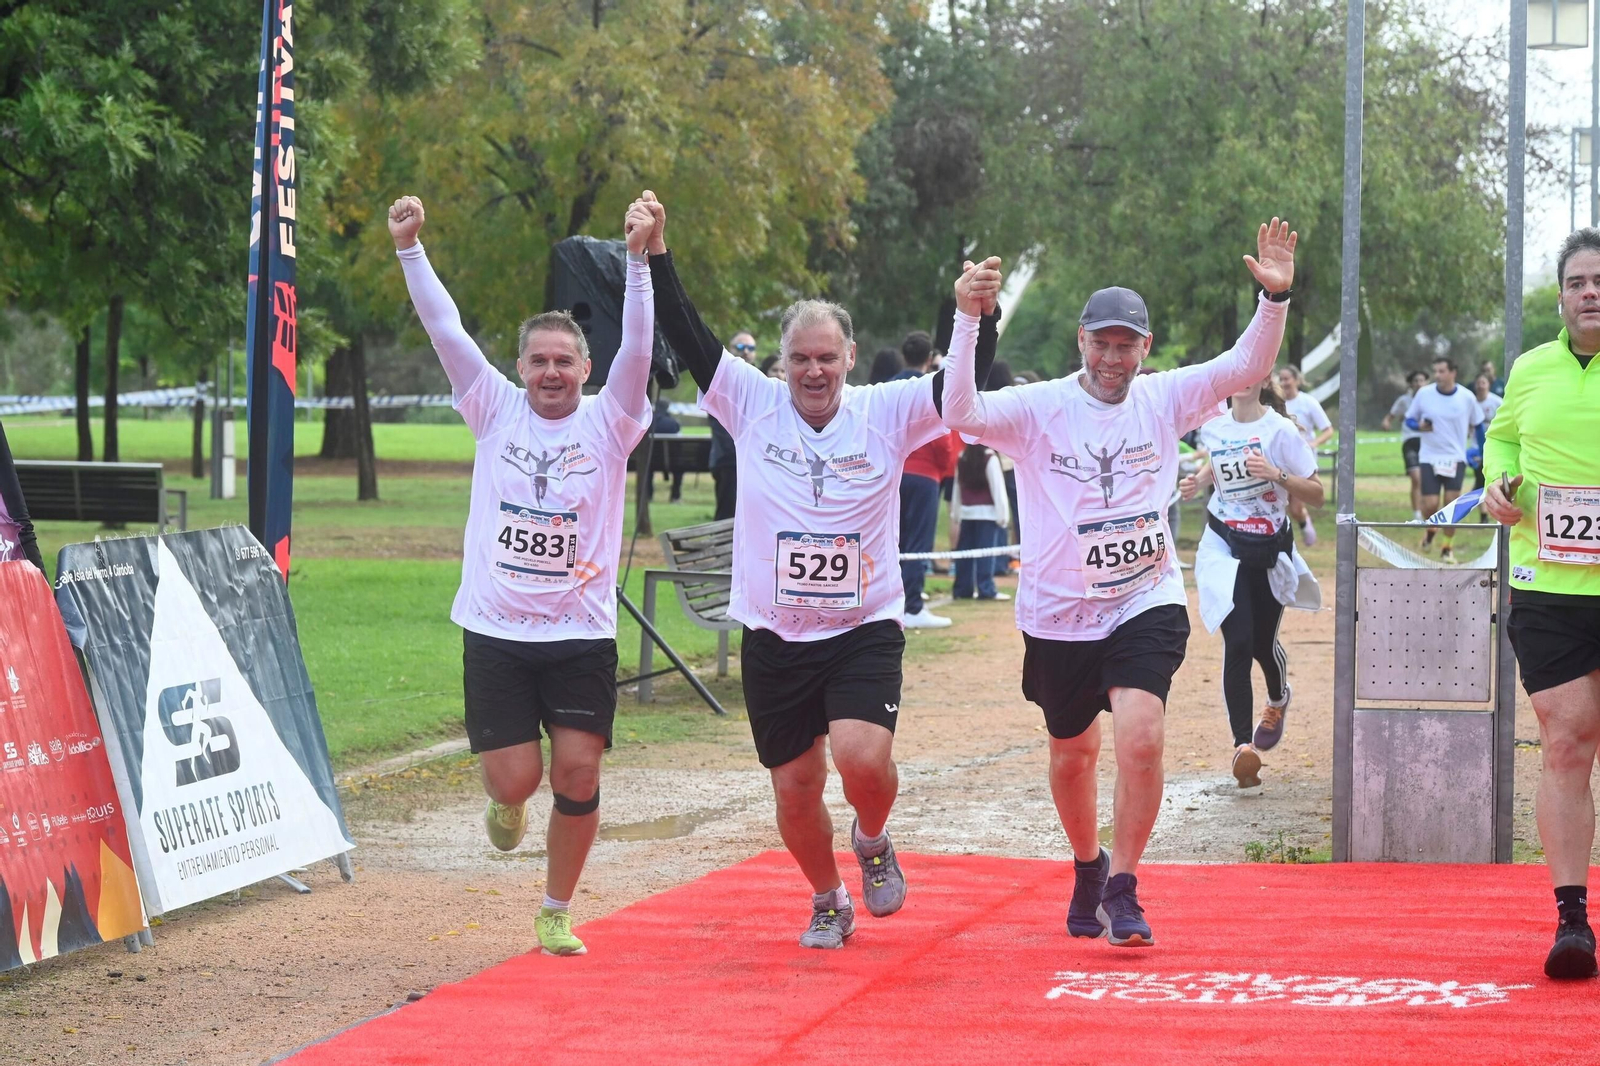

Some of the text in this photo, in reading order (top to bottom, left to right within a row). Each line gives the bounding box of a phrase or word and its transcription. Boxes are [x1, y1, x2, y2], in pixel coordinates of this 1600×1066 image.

[498, 525, 565, 558] 4583
[1086, 536, 1156, 570] 4584
[74, 568, 86, 582] Isla
[788, 552, 849, 582] 529
[153, 780, 280, 854] SUPERATE SPORTS
[177, 833, 280, 880] ENTRENAMIENTO PERSONAL
